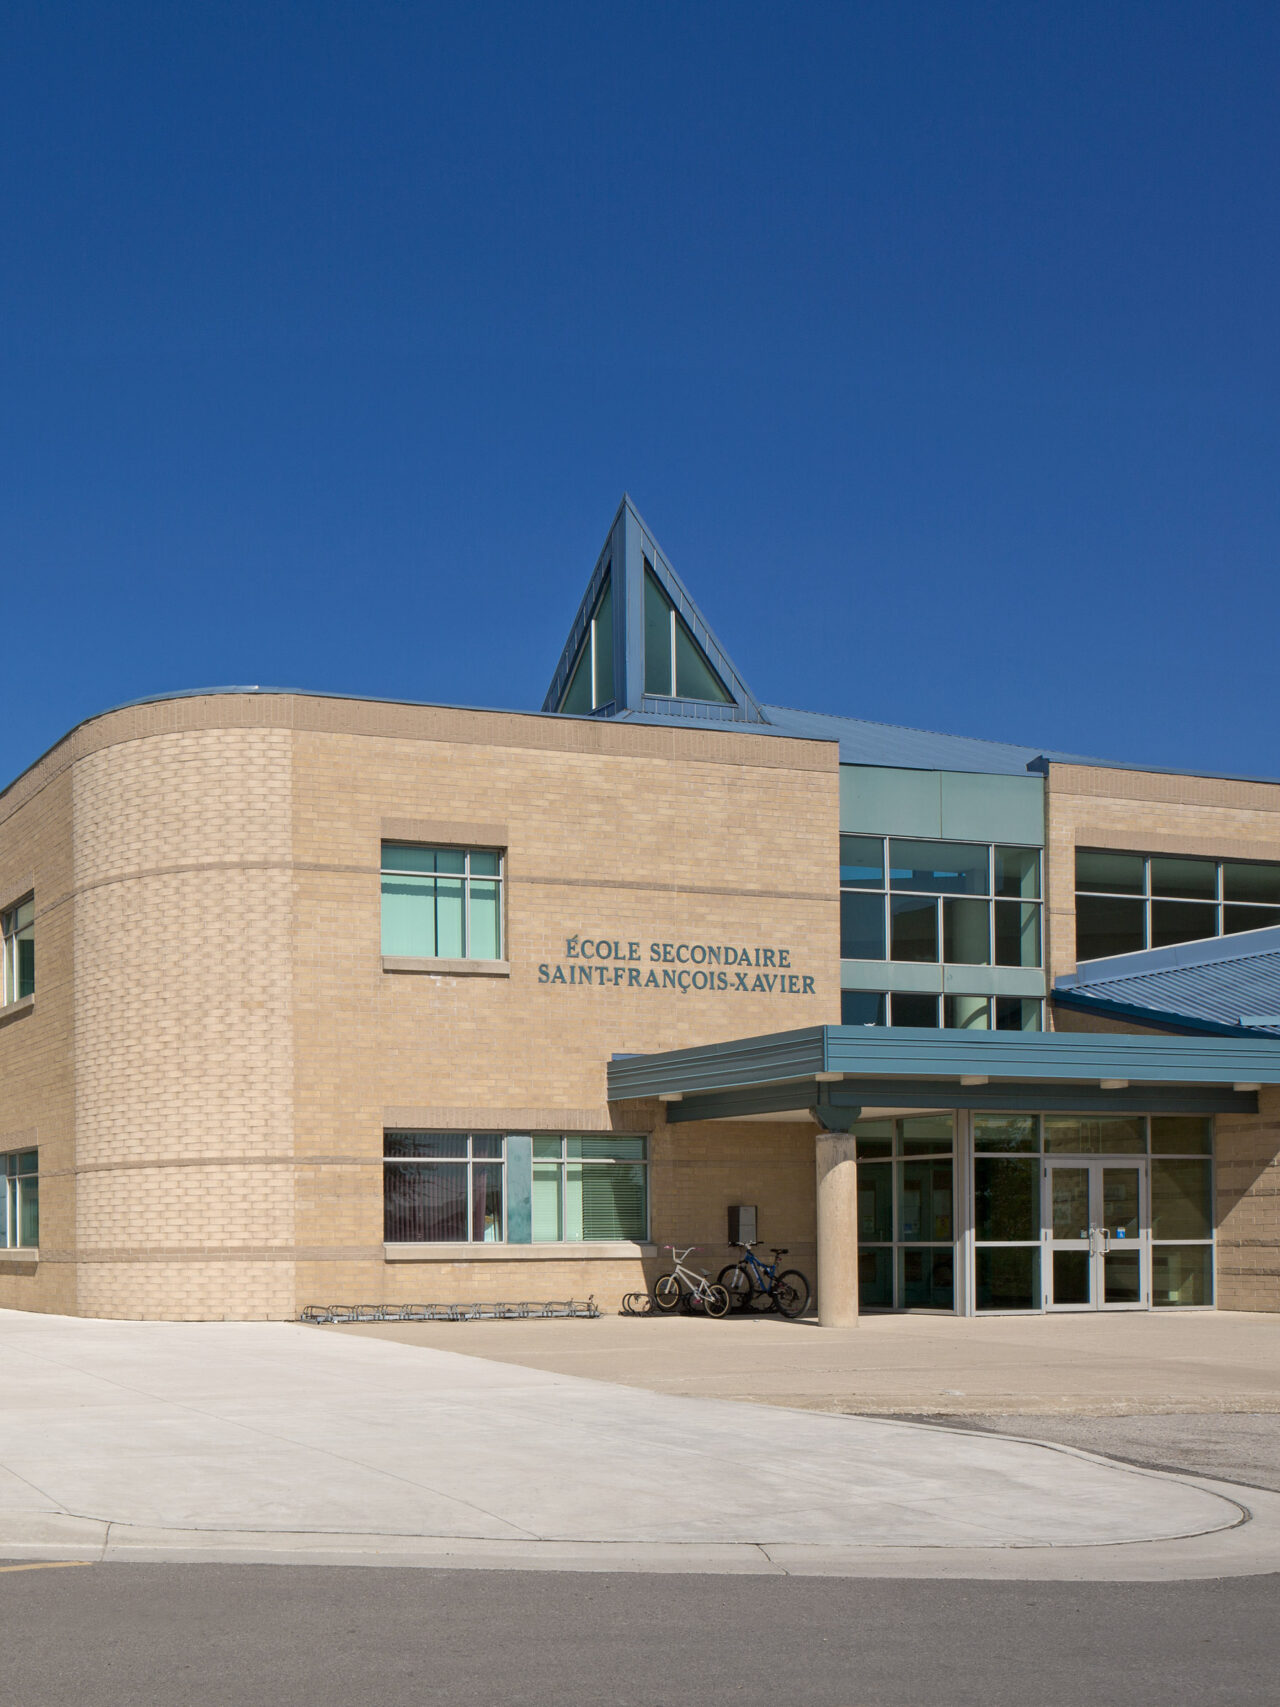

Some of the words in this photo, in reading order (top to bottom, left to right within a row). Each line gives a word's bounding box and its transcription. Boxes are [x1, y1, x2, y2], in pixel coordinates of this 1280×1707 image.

[566, 934, 642, 961] ÉCOLE
[649, 942, 791, 968] SECONDAIRE
[538, 963, 817, 995] SAINT-FRANÇOIS-XAVIER
